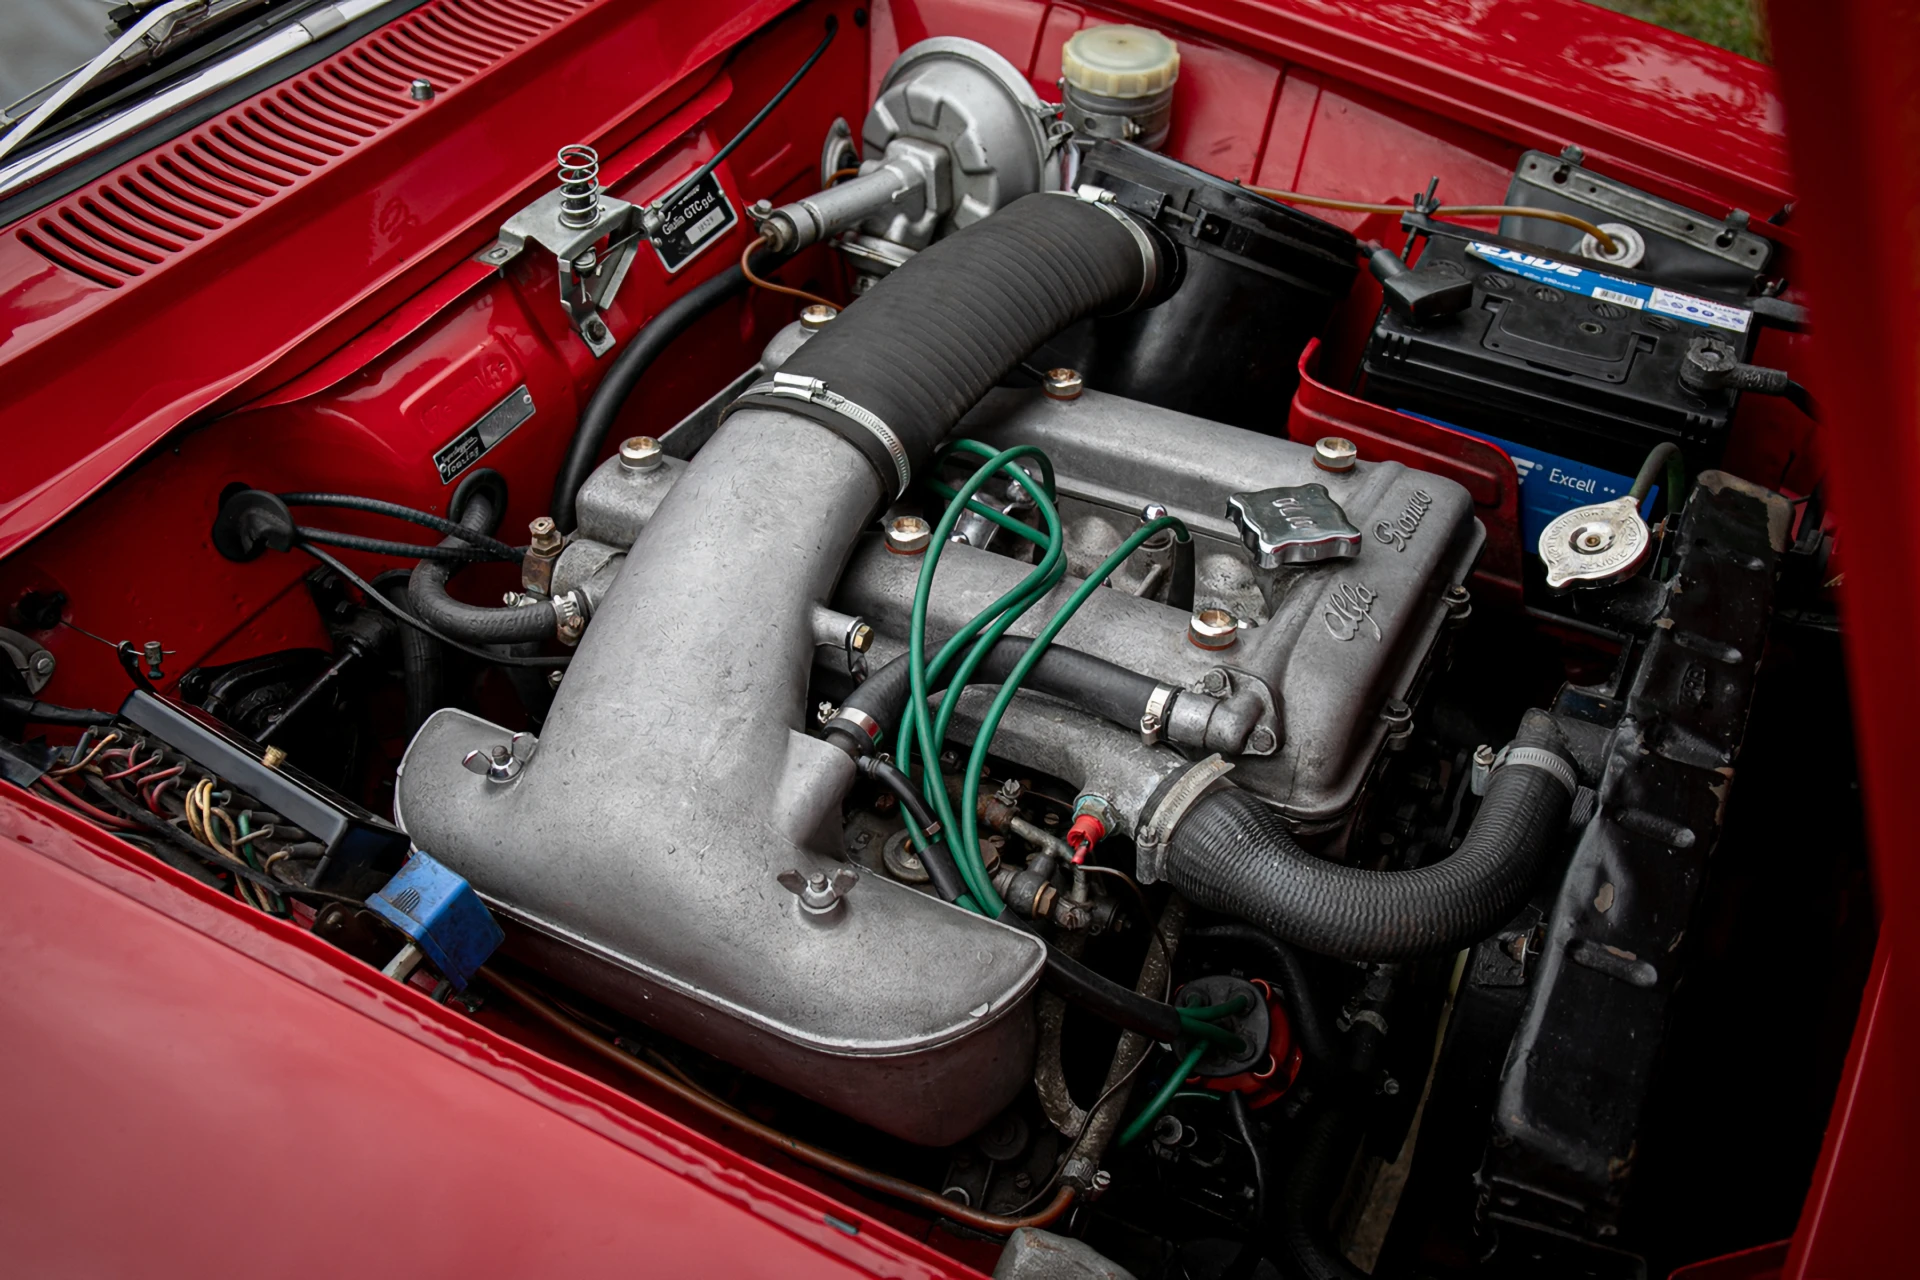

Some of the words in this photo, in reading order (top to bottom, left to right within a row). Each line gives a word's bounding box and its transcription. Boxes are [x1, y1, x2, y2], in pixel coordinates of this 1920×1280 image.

[662, 215, 686, 235] Giulia
[1474, 242, 1583, 277] EXIDE
[1549, 468, 1597, 494] Excell
[1323, 582, 1383, 642] Alfa
[1372, 489, 1432, 552] Romeo
